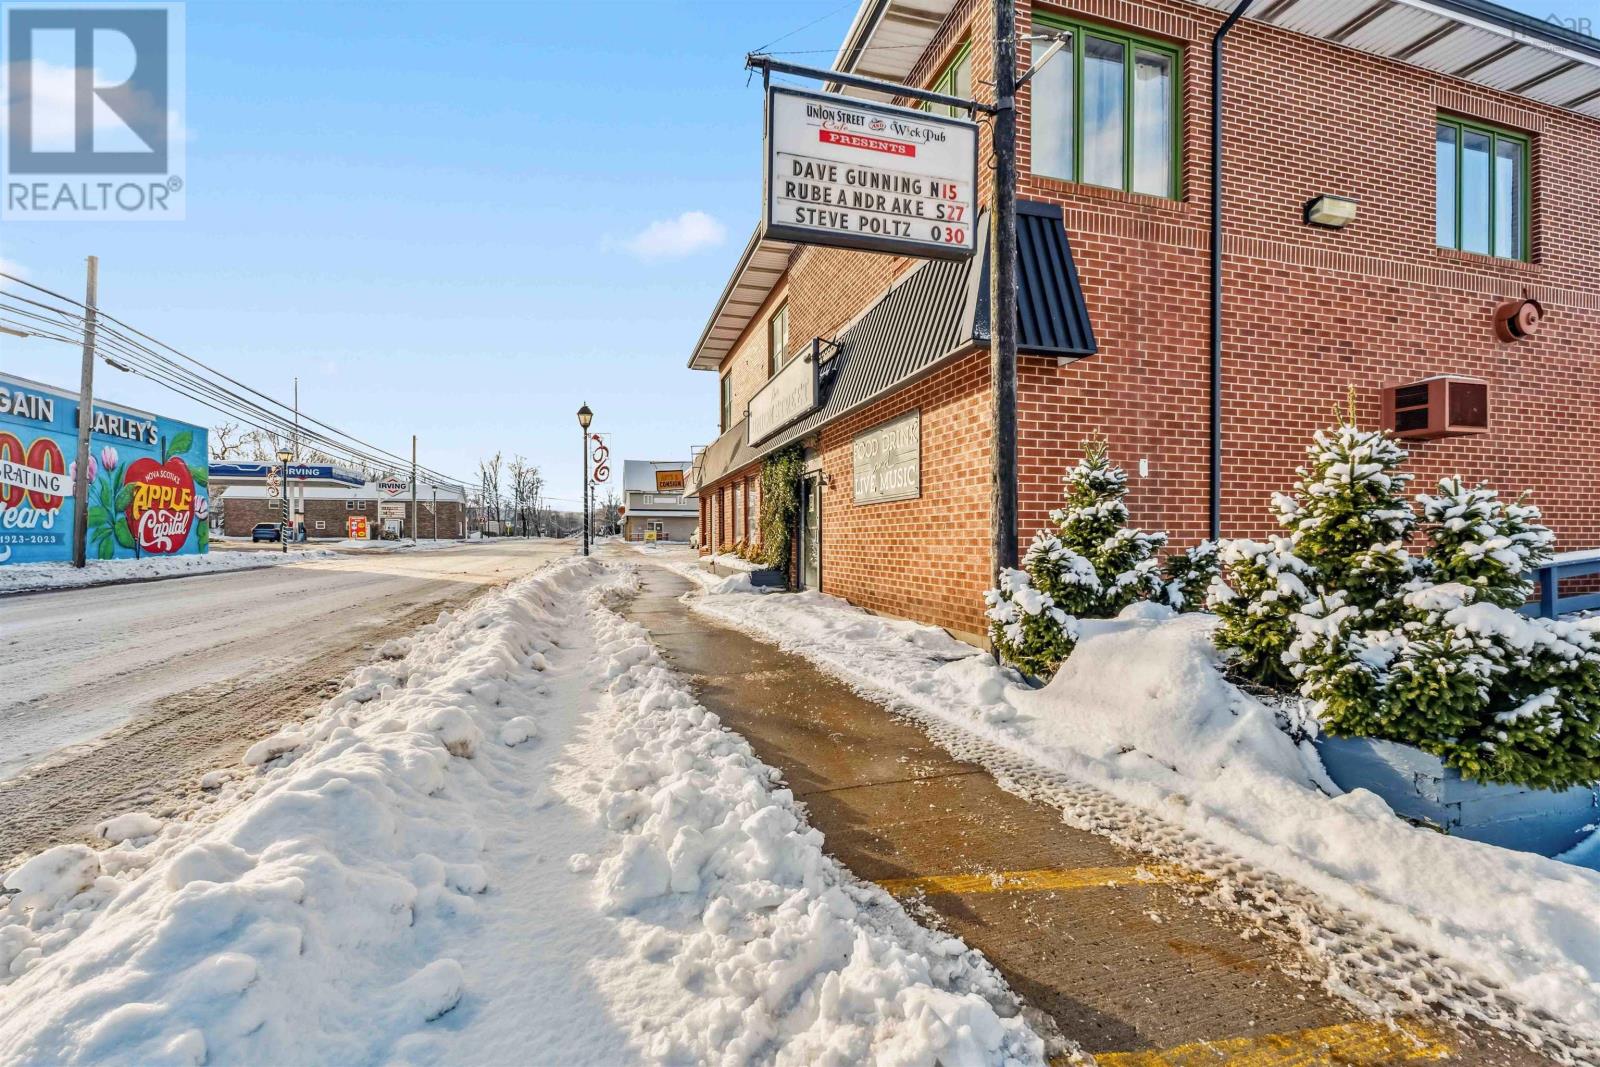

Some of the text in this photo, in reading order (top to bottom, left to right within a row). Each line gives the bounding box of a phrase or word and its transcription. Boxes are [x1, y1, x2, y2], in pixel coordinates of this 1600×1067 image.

[806, 105, 866, 127] UNION STREET
[829, 132, 907, 154] PRESENTS
[922, 128, 946, 144] Pub
[792, 159, 838, 183] DAVE
[845, 168, 922, 195] GUNNING
[785, 180, 832, 204] RUBE
[795, 206, 849, 230] STEVE
[859, 214, 911, 238] POLTZ
[76, 406, 158, 445] ARLEY'S
[882, 417, 918, 454] DRINK
[0, 463, 61, 492] RATING
[145, 470, 160, 482] NOVA
[285, 468, 320, 476] RVING
[378, 482, 407, 490] IRVING
[855, 464, 917, 496] LIVE MUSIC
[133, 481, 193, 520] APPLE
[138, 509, 190, 551] Capital
